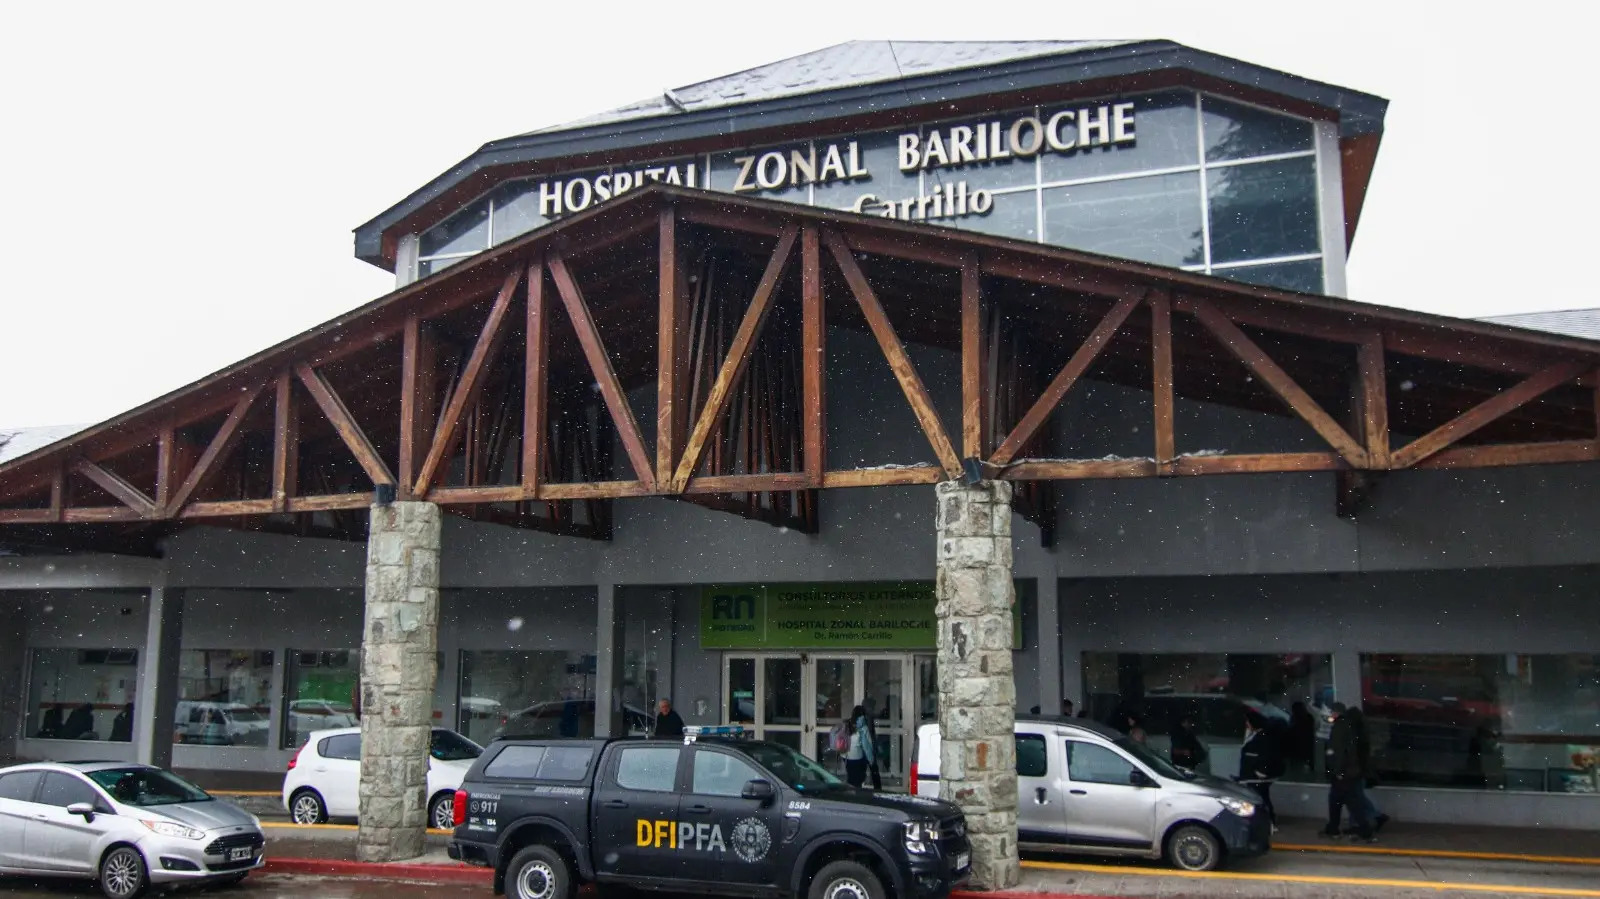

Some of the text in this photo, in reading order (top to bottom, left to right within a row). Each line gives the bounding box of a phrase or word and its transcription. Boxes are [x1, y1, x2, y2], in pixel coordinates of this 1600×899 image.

[733, 141, 868, 192] ZONAL
[899, 102, 1136, 171] BARILOCHE
[854, 181, 993, 220] Carrillo
[869, 591, 933, 601] EXTERNOS
[778, 620, 932, 630] HOSPITAL ZONAL BARILOCHE
[814, 631, 827, 640] Dr.
[861, 631, 893, 640] Carrillo
[481, 800, 498, 813] 911
